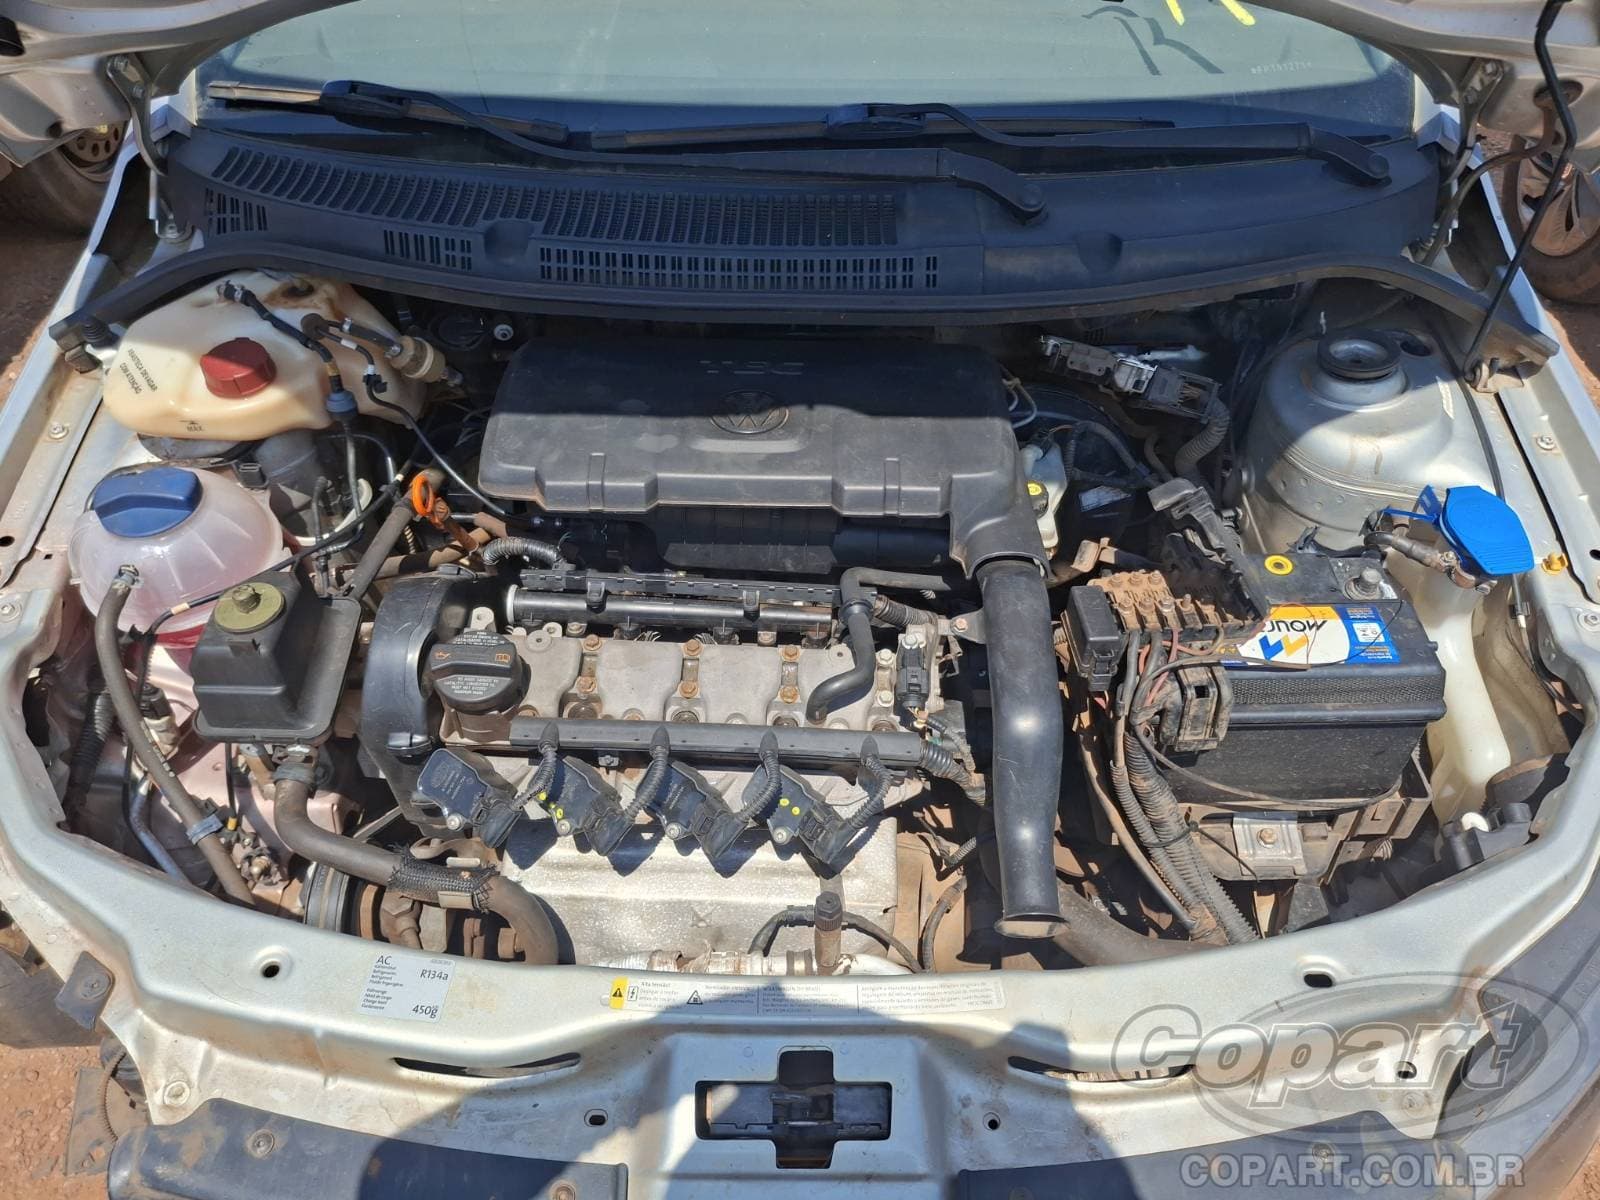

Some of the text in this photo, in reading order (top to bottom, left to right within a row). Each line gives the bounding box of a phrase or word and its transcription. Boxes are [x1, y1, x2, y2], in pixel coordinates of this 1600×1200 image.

[376, 955, 392, 965] AC
[420, 969, 449, 981] R134a
[412, 1004, 439, 1019] 450g
